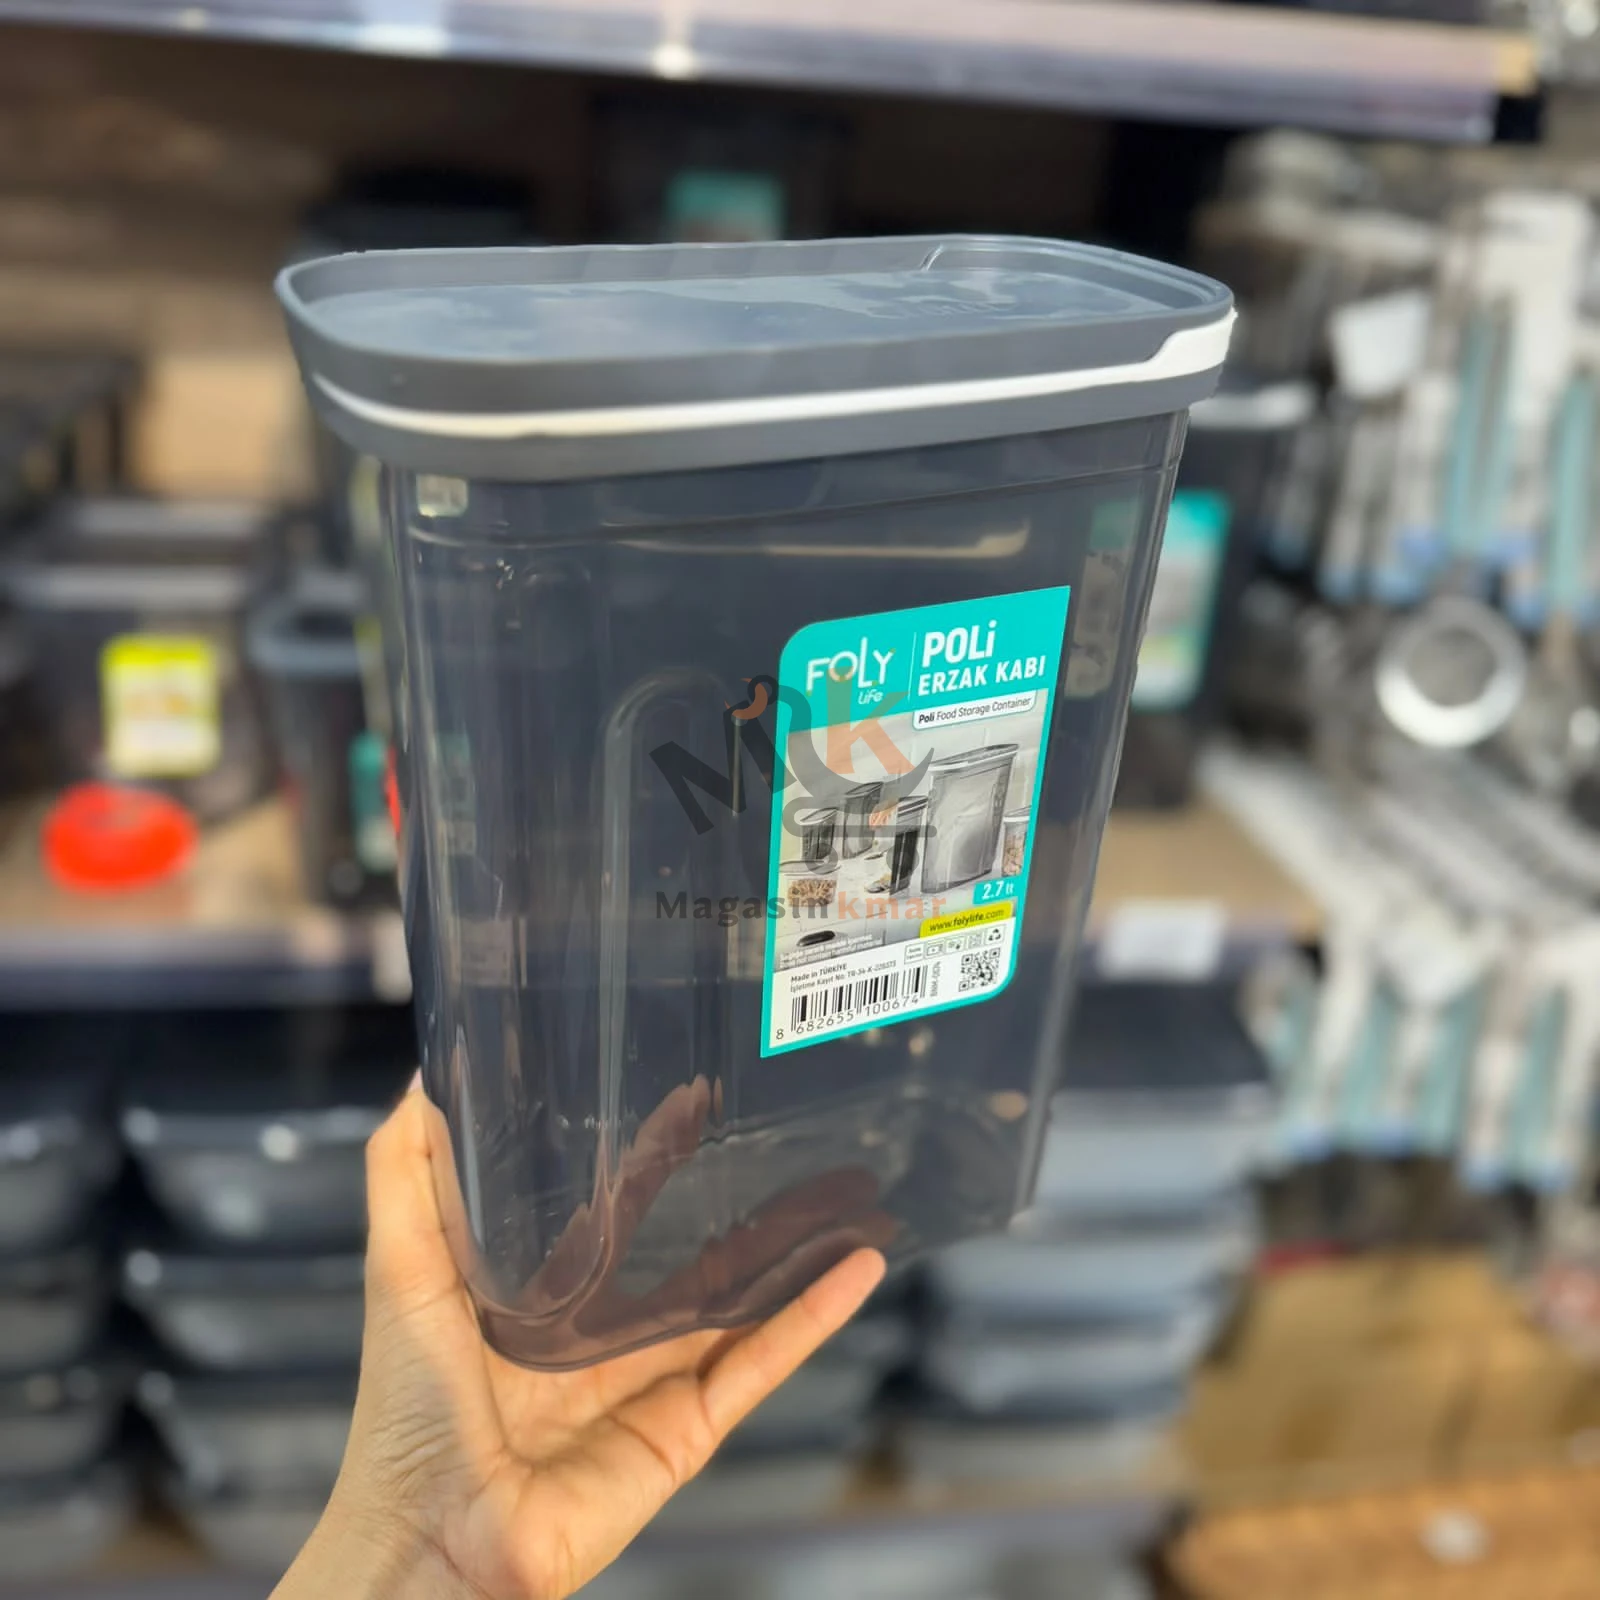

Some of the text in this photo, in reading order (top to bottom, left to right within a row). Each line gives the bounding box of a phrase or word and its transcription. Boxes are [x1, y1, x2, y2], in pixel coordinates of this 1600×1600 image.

[806, 636, 896, 697] FOLY
[917, 655, 1046, 696] ERZAK KABI
[918, 697, 1031, 724] Poli Food Storage Container
[982, 880, 1004, 900] 2.7
[929, 909, 1004, 931] www.folylife.com
[790, 973, 810, 982] Made
[811, 969, 819, 979] in
[775, 994, 919, 1040] 8 682655 100674
